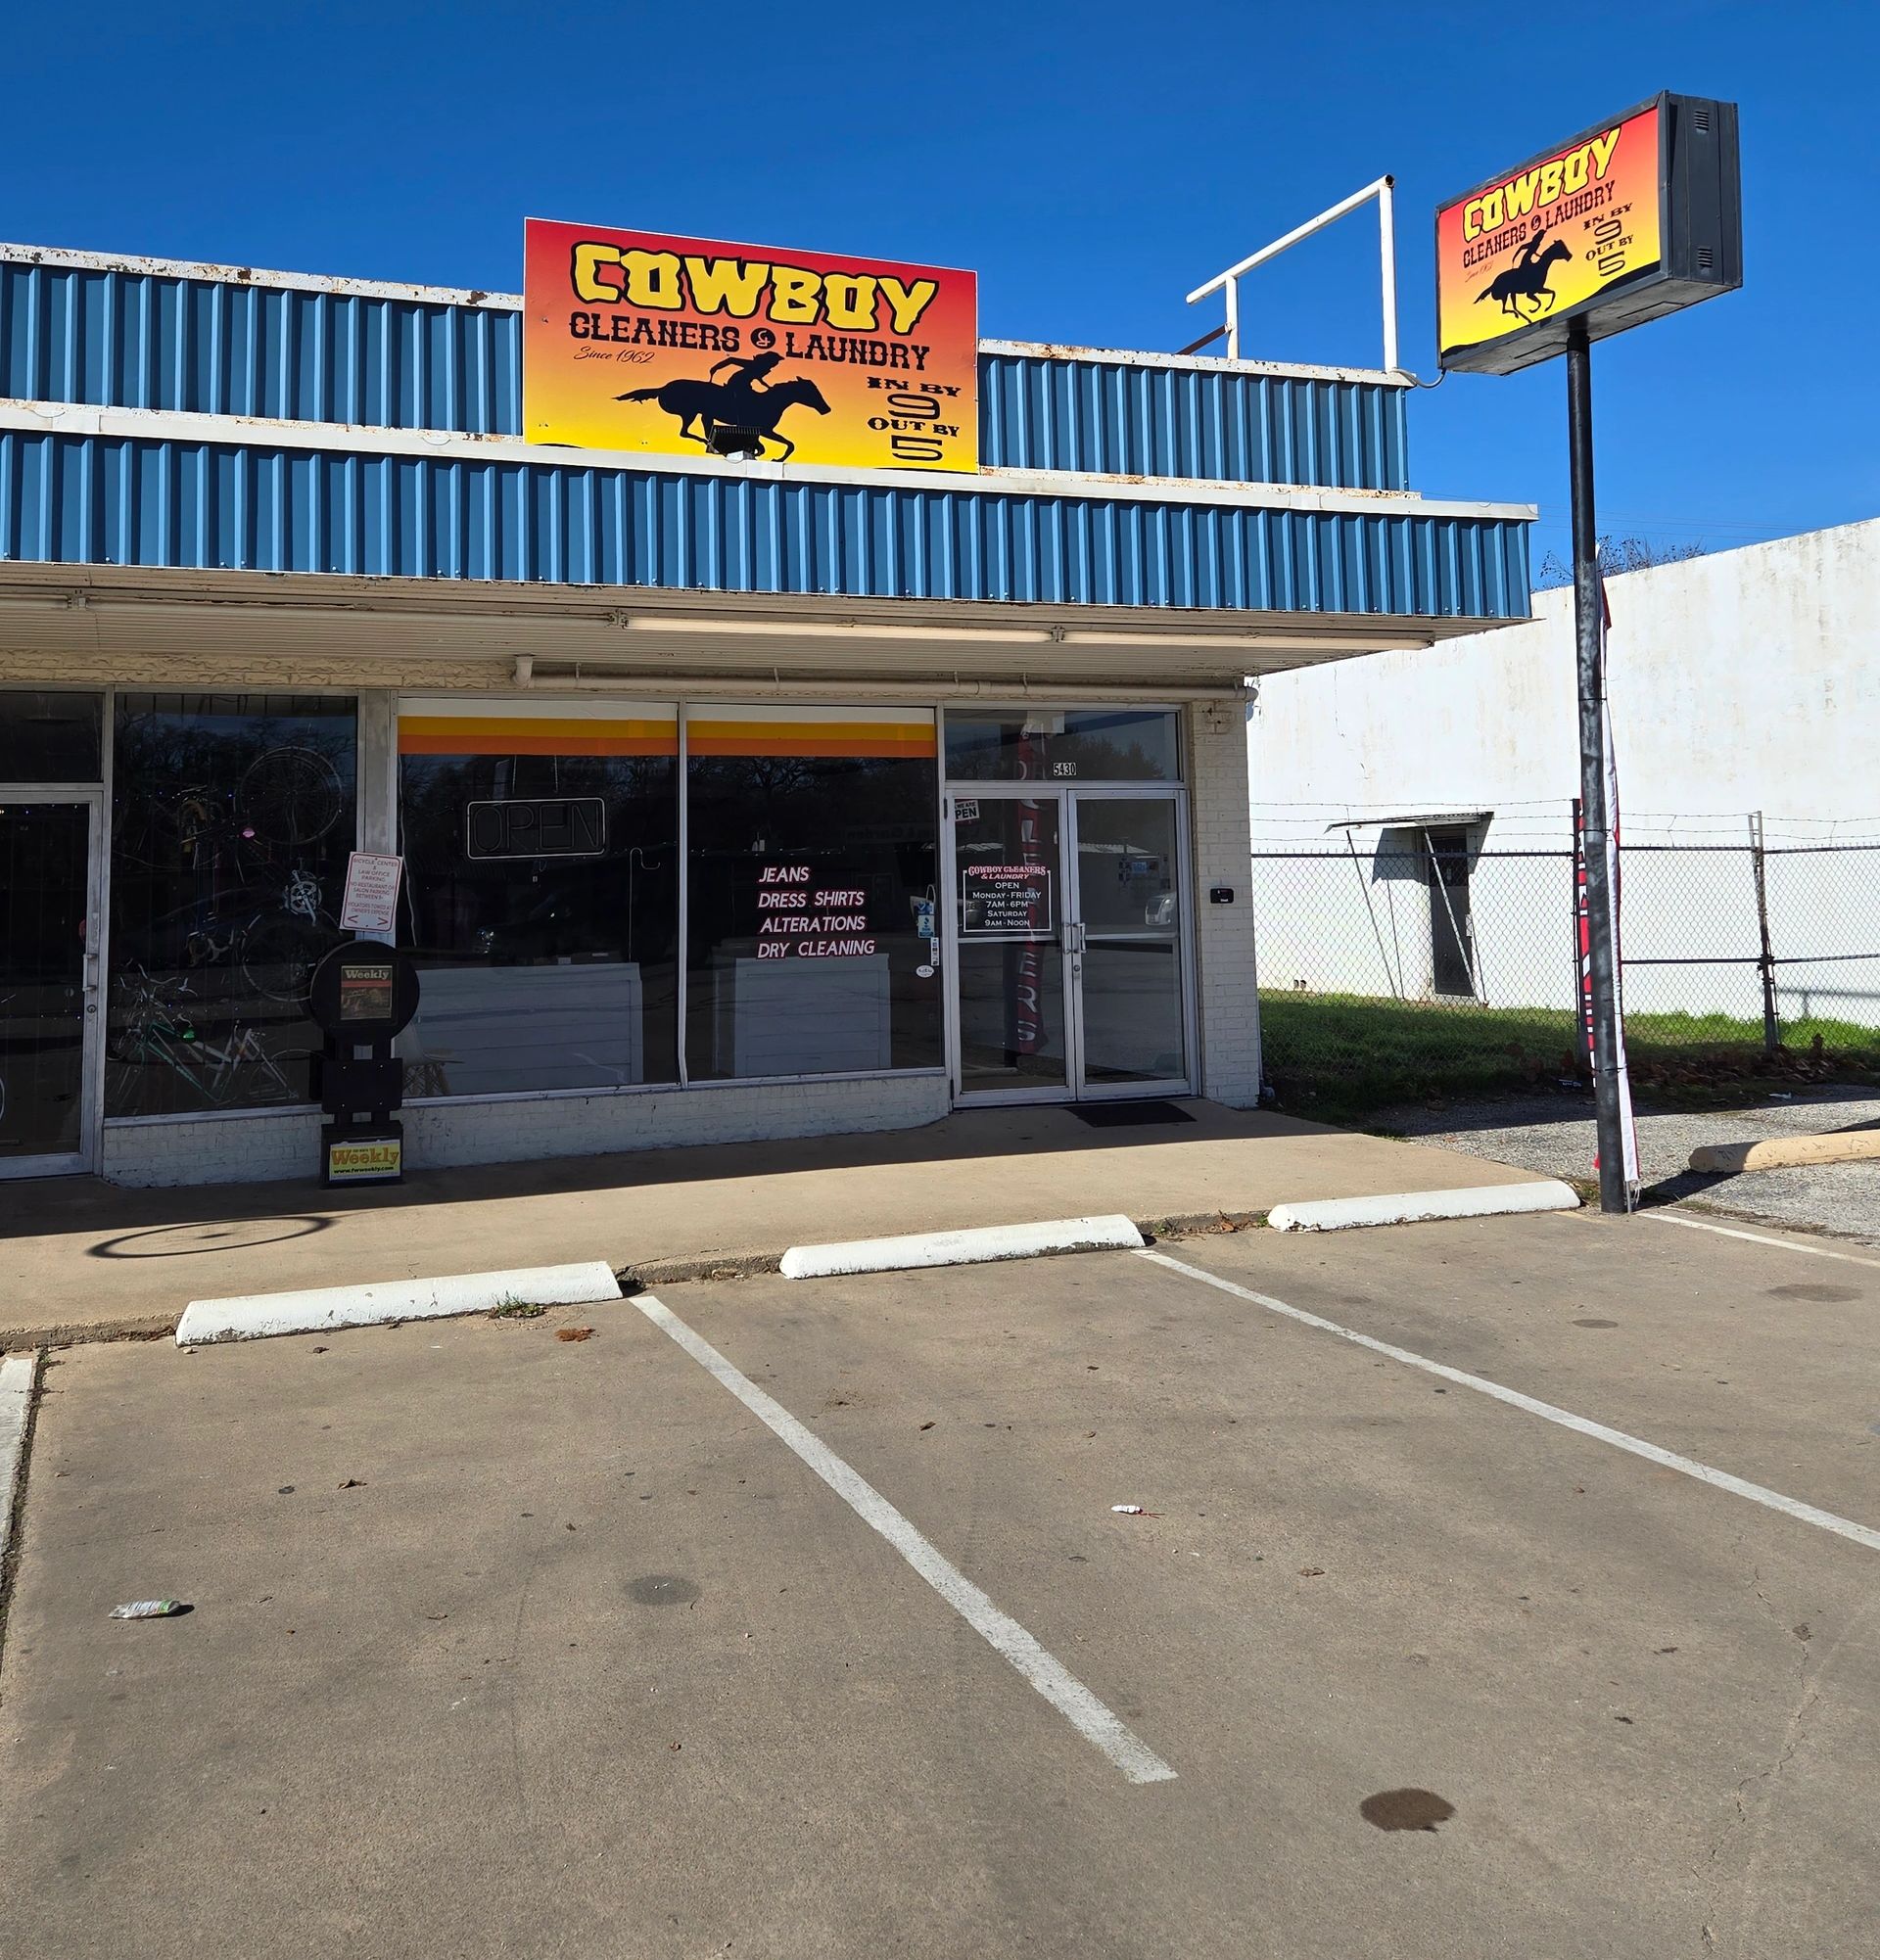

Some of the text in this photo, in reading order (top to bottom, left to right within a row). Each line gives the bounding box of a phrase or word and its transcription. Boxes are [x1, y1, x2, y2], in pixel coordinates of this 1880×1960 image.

[1463, 125, 1622, 244] COWBOY
[1463, 220, 1527, 268] CLEANERS
[1545, 180, 1616, 230] LAUNDRY
[1583, 202, 1633, 230] IN BY
[1594, 218, 1622, 245] 9
[1585, 234, 1634, 261] OUT BY
[1598, 251, 1625, 277] 5
[570, 241, 940, 335] COWBOY
[569, 311, 740, 352] CLEANERS
[785, 331, 930, 371] LAUNDRY
[574, 346, 656, 365] Since 1962
[867, 376, 963, 397] IN BY
[886, 394, 941, 420] 9
[867, 416, 961, 437] OUT BY
[891, 435, 943, 461] 5
[1055, 763, 1075, 775] 5430
[955, 807, 977, 819] PEN
[474, 804, 599, 853] OPEN
[758, 866, 810, 883] JEANS
[968, 865, 1046, 876] COWBOY CLEANERS
[758, 891, 865, 908] DRESS SHIRTS
[760, 915, 866, 933] ALTERATIONS
[757, 940, 875, 958] DRY CLEANING
[345, 969, 390, 980] Weekly
[331, 1146, 400, 1165] Weekly
